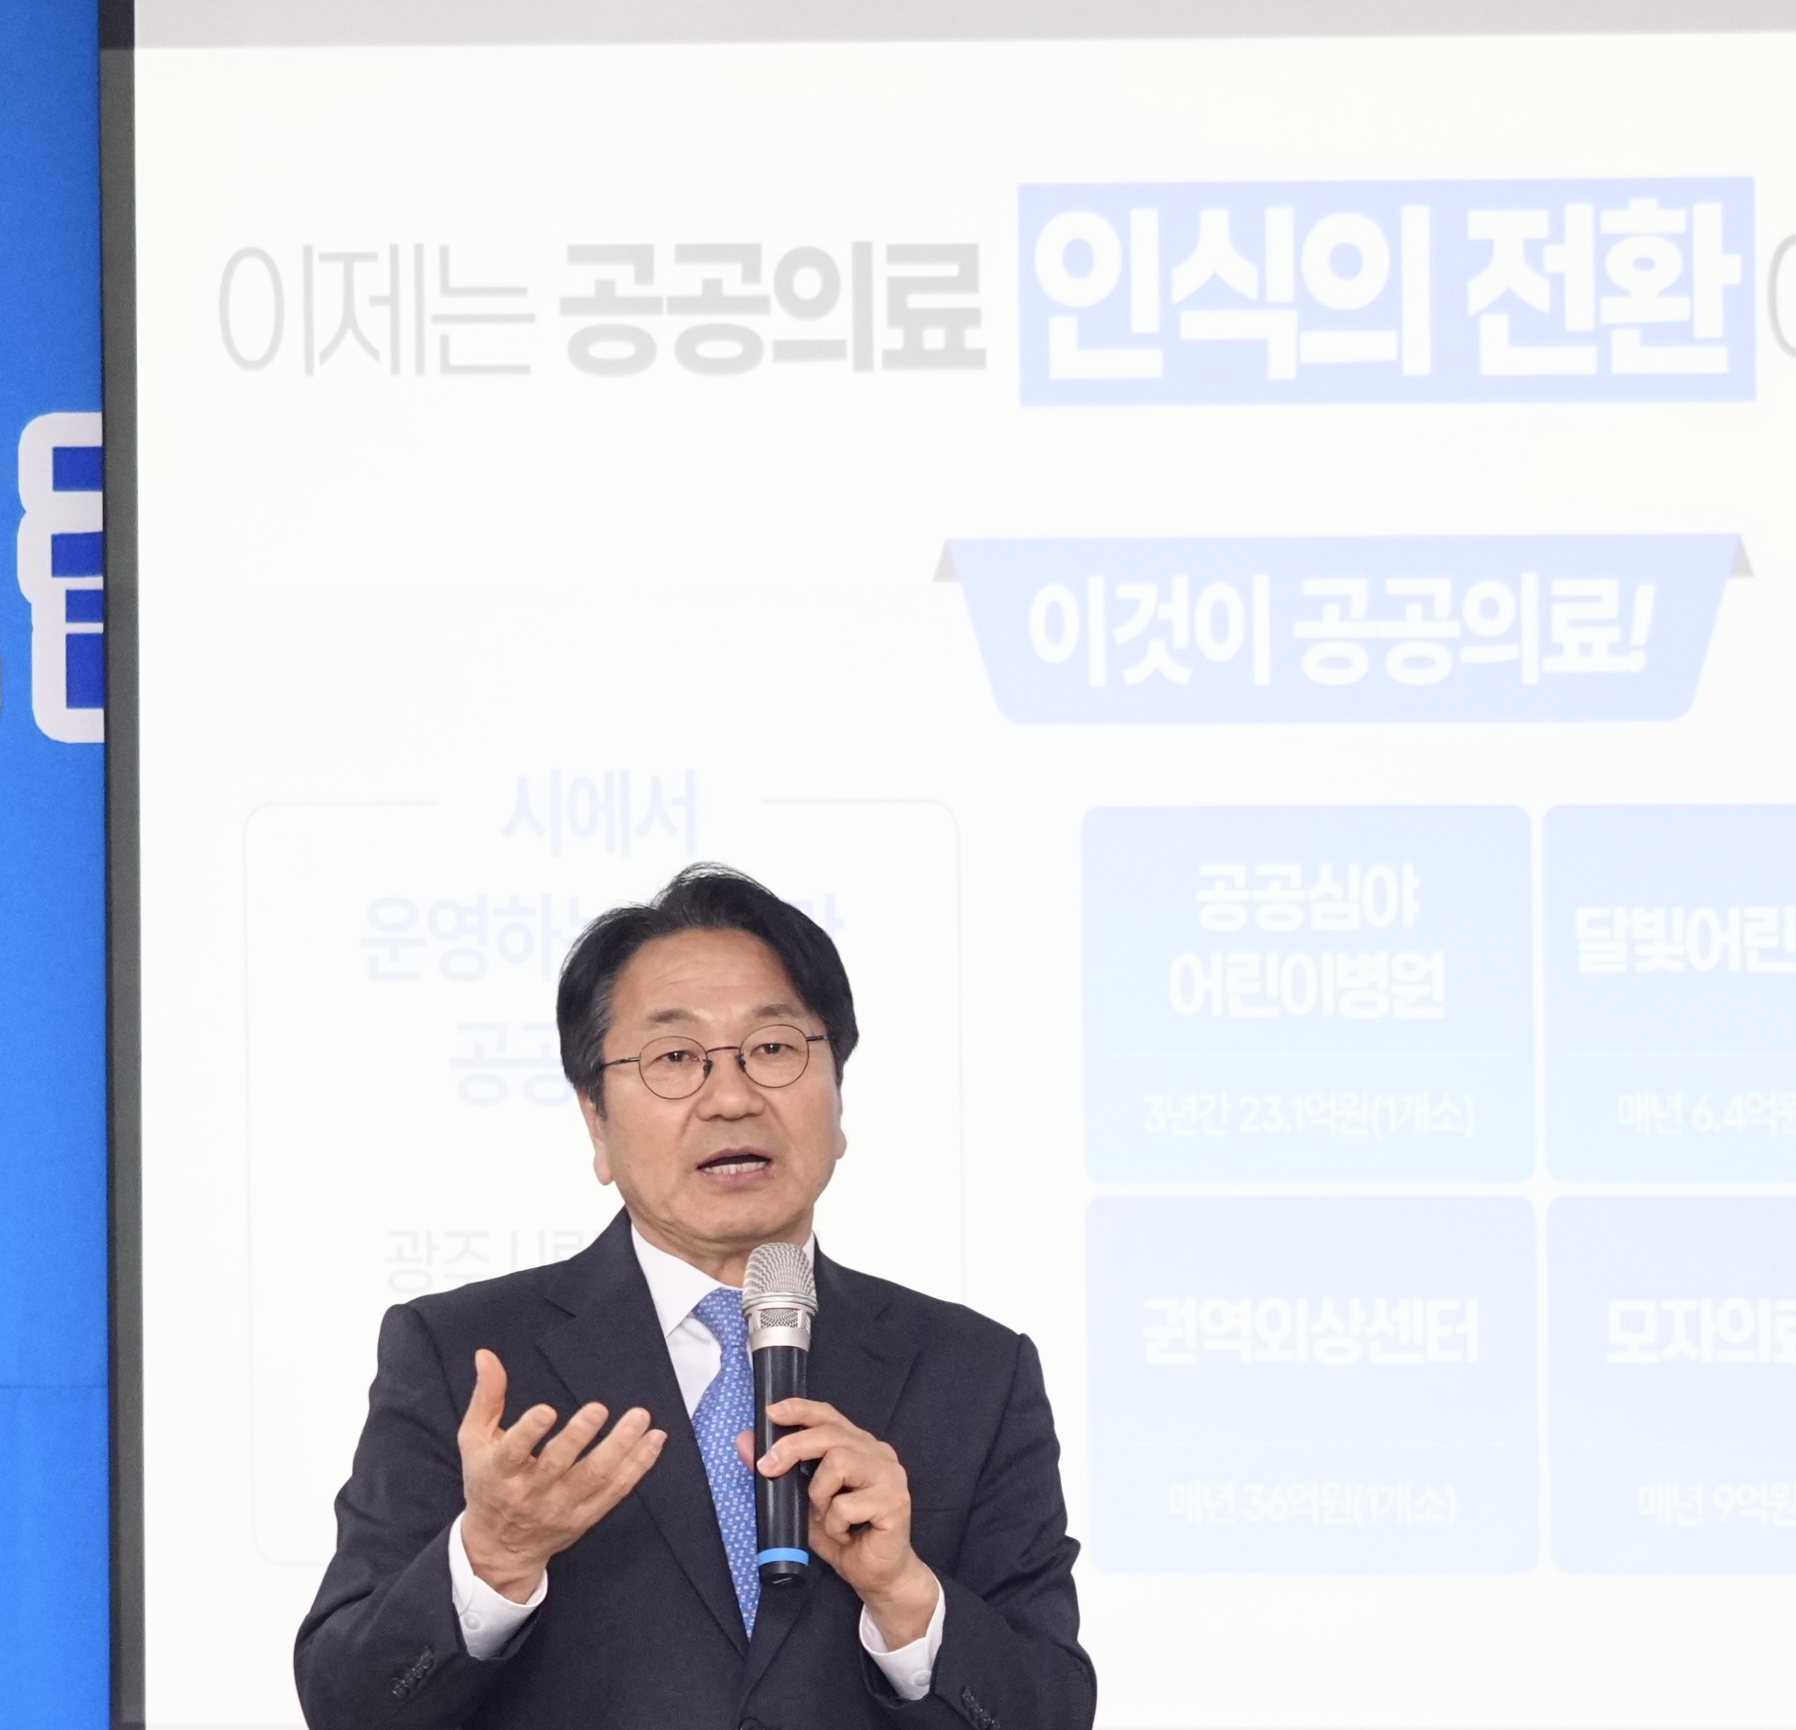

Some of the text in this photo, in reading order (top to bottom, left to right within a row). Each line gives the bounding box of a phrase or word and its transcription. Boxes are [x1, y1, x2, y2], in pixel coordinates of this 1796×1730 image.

[218, 242, 536, 377] 이제는
[559, 240, 987, 377] 공공의료
[1034, 205, 1432, 381] 인식의
[1029, 572, 1656, 688] 이것이 공공의료!
[500, 768, 700, 860] 시에서
[1196, 862, 1421, 933] 공공심야
[359, 892, 589, 984] 운영하
[1168, 951, 1446, 1020] 어린이병원
[1141, 1088, 1477, 1140] 3년간 23.1억원(1개소)
[1616, 1088, 1683, 1138] 매년
[1142, 1297, 1479, 1367] 권역외상센터
[1167, 1478, 1459, 1530] 매년 36억원(1개소)
[1637, 1480, 1706, 1530] 매년
